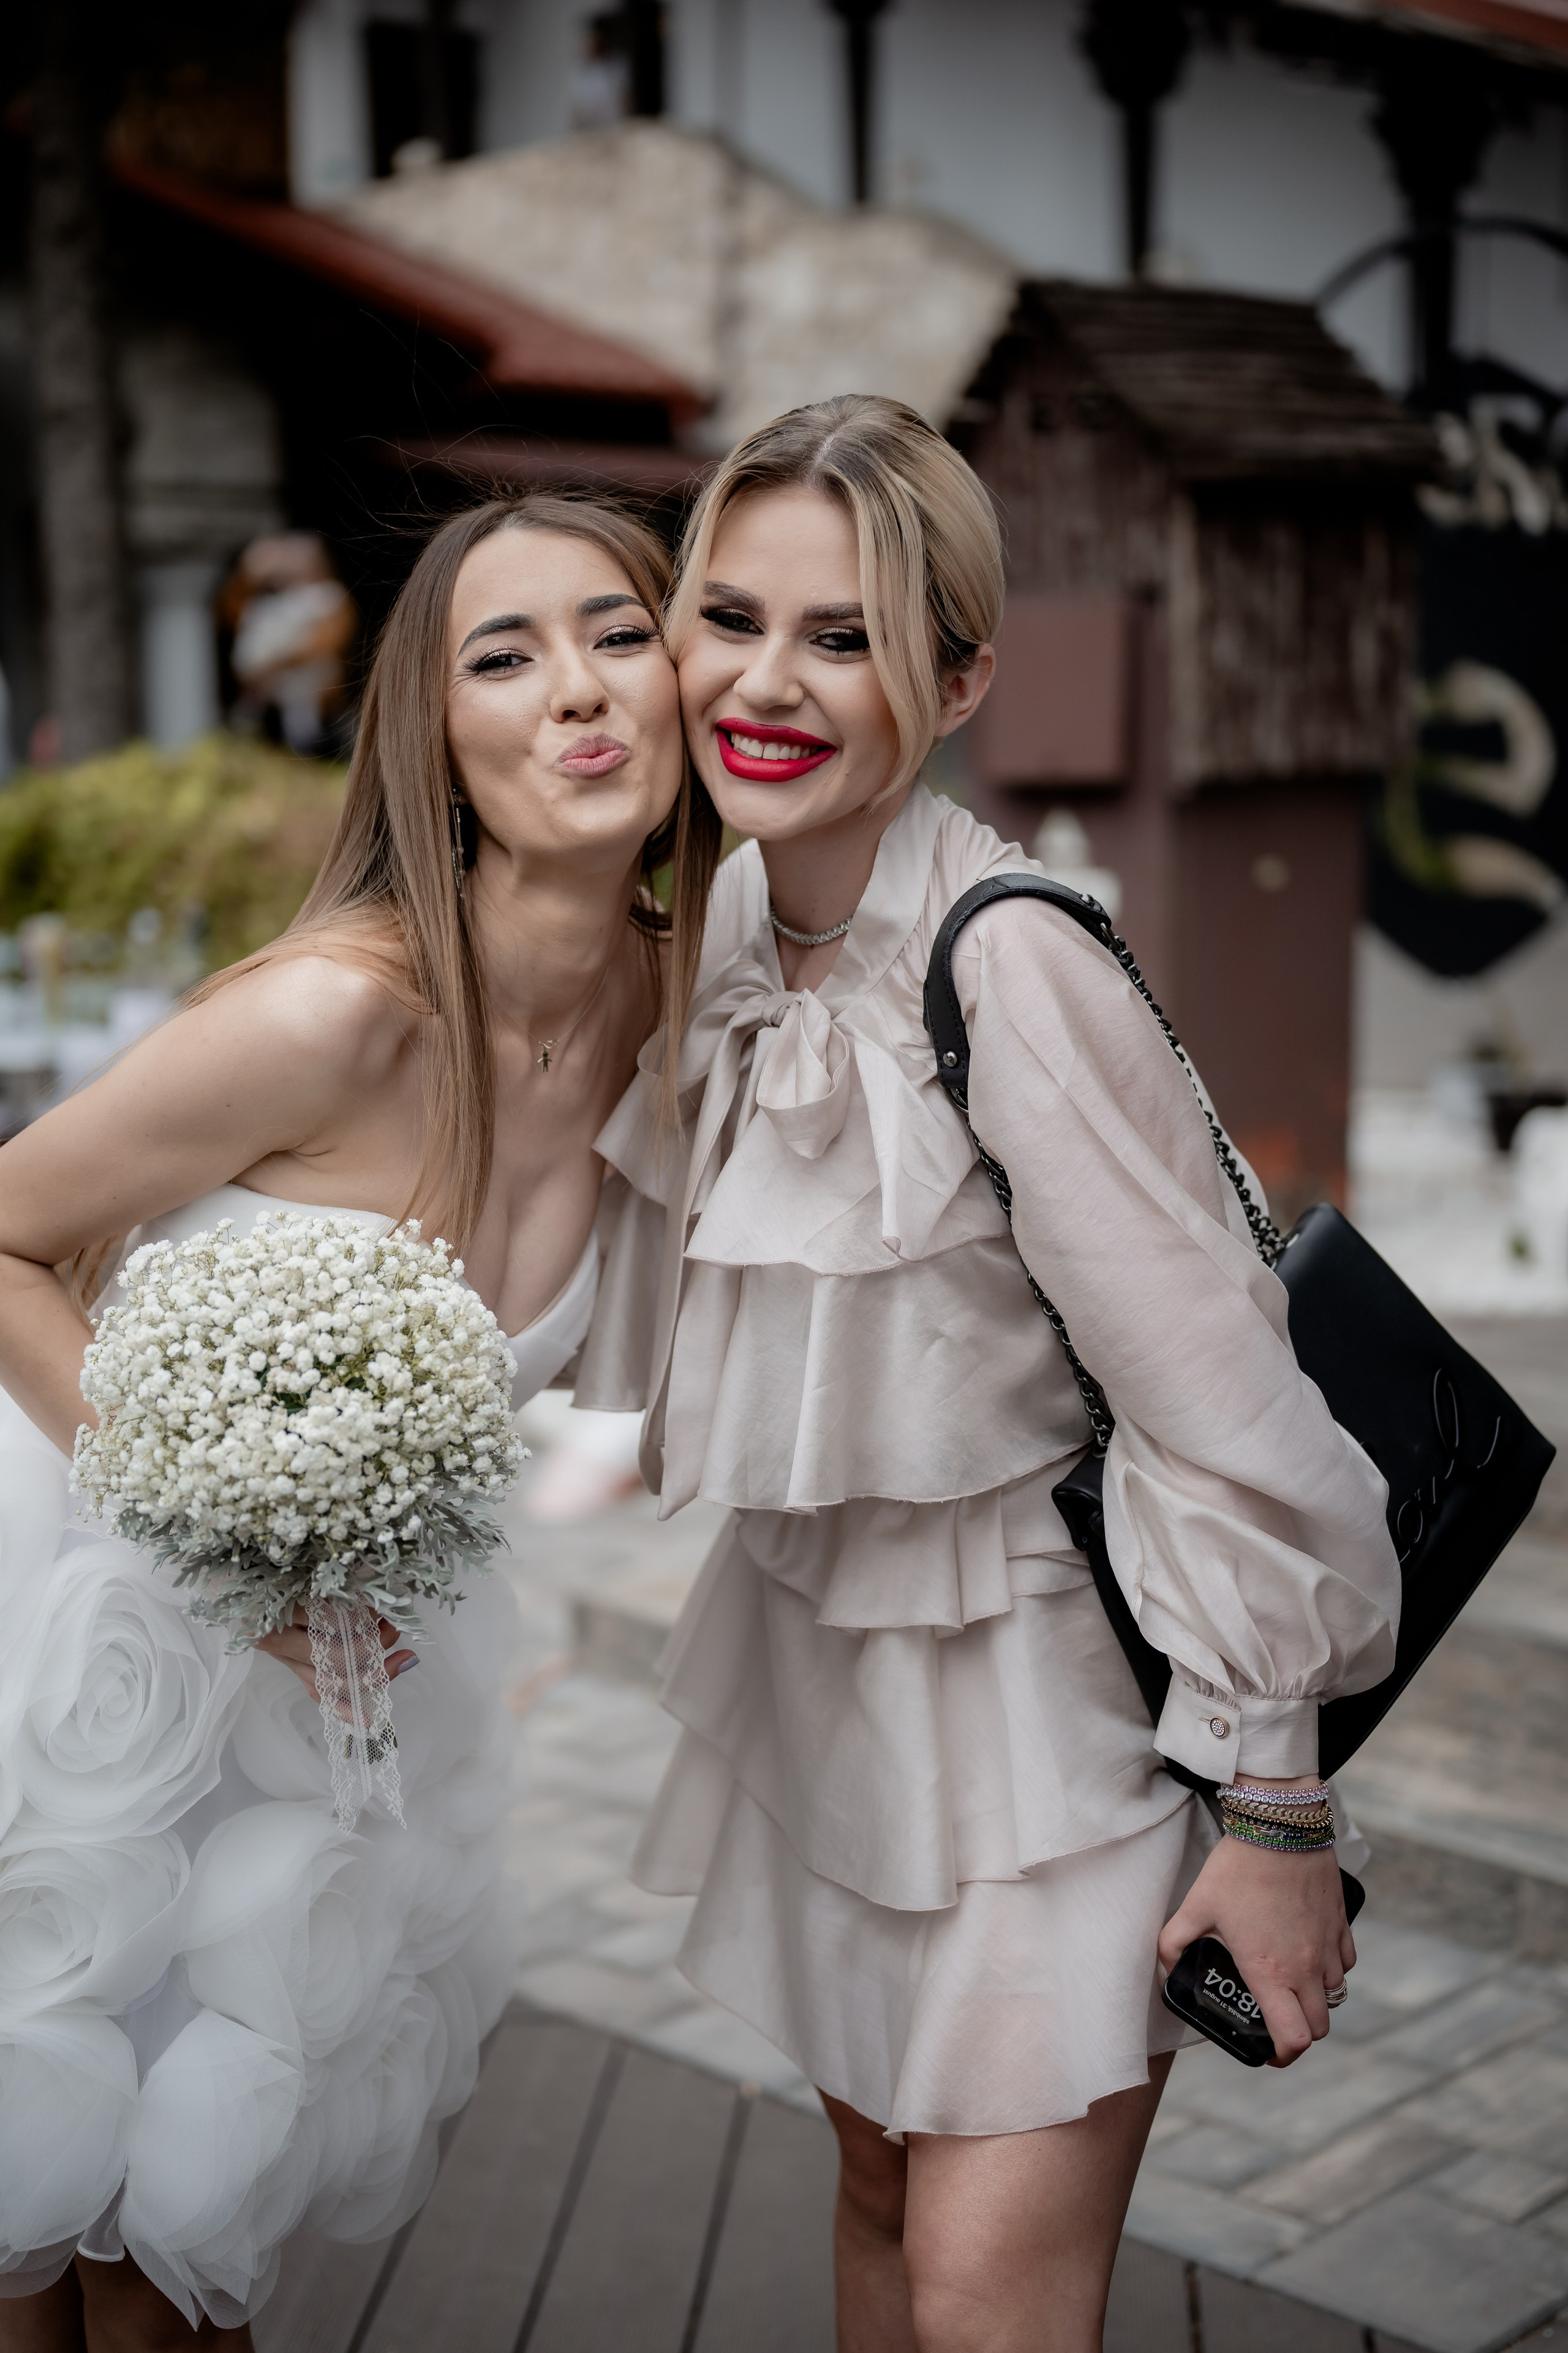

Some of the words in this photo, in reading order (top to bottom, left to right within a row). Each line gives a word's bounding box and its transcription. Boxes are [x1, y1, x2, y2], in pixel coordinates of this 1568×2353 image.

[1363, 1367, 1502, 1563] arl
[1203, 1989, 1221, 2003] august
[1204, 1968, 1261, 2018] 18:04
